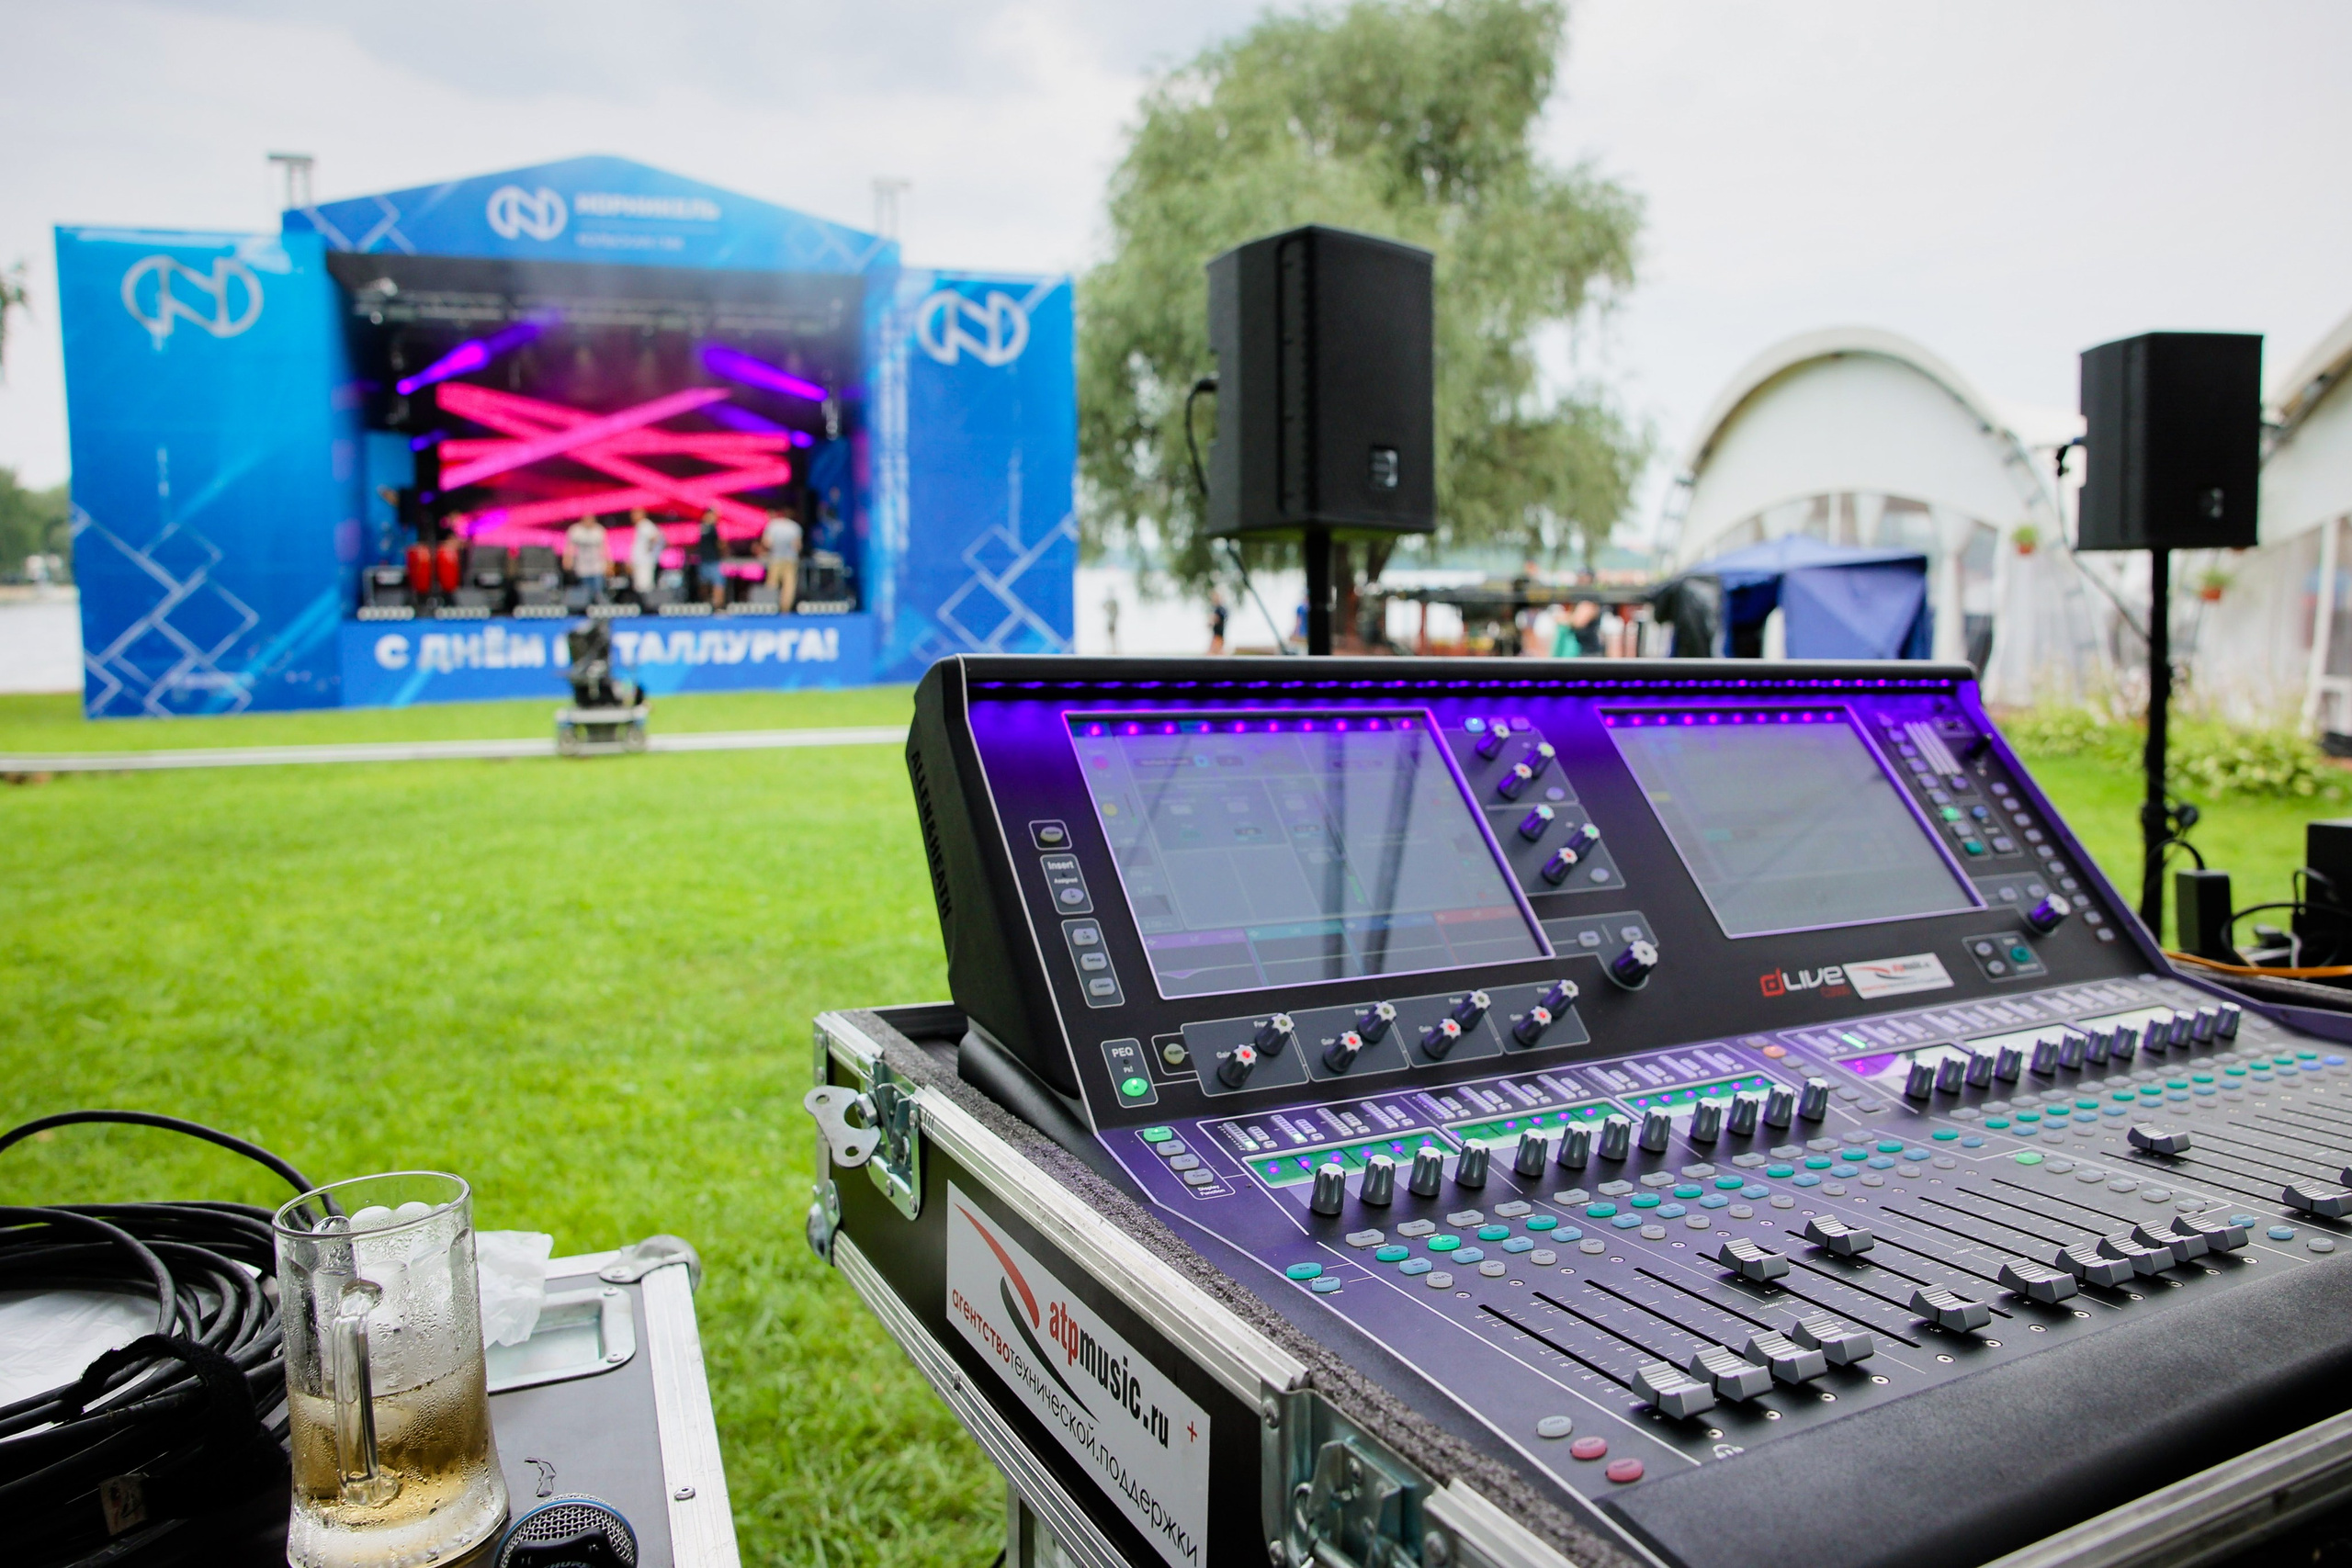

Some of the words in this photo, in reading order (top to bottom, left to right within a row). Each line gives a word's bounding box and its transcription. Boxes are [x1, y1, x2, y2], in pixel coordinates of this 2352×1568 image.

[418, 626, 546, 673] ДНЁМ
[554, 627, 840, 668] ТАЛЛУРГА!
[1046, 860, 1075, 871] Insert
[1111, 1046, 1135, 1057] PEQ
[1049, 1301, 1170, 1449] atpmusic.ru
